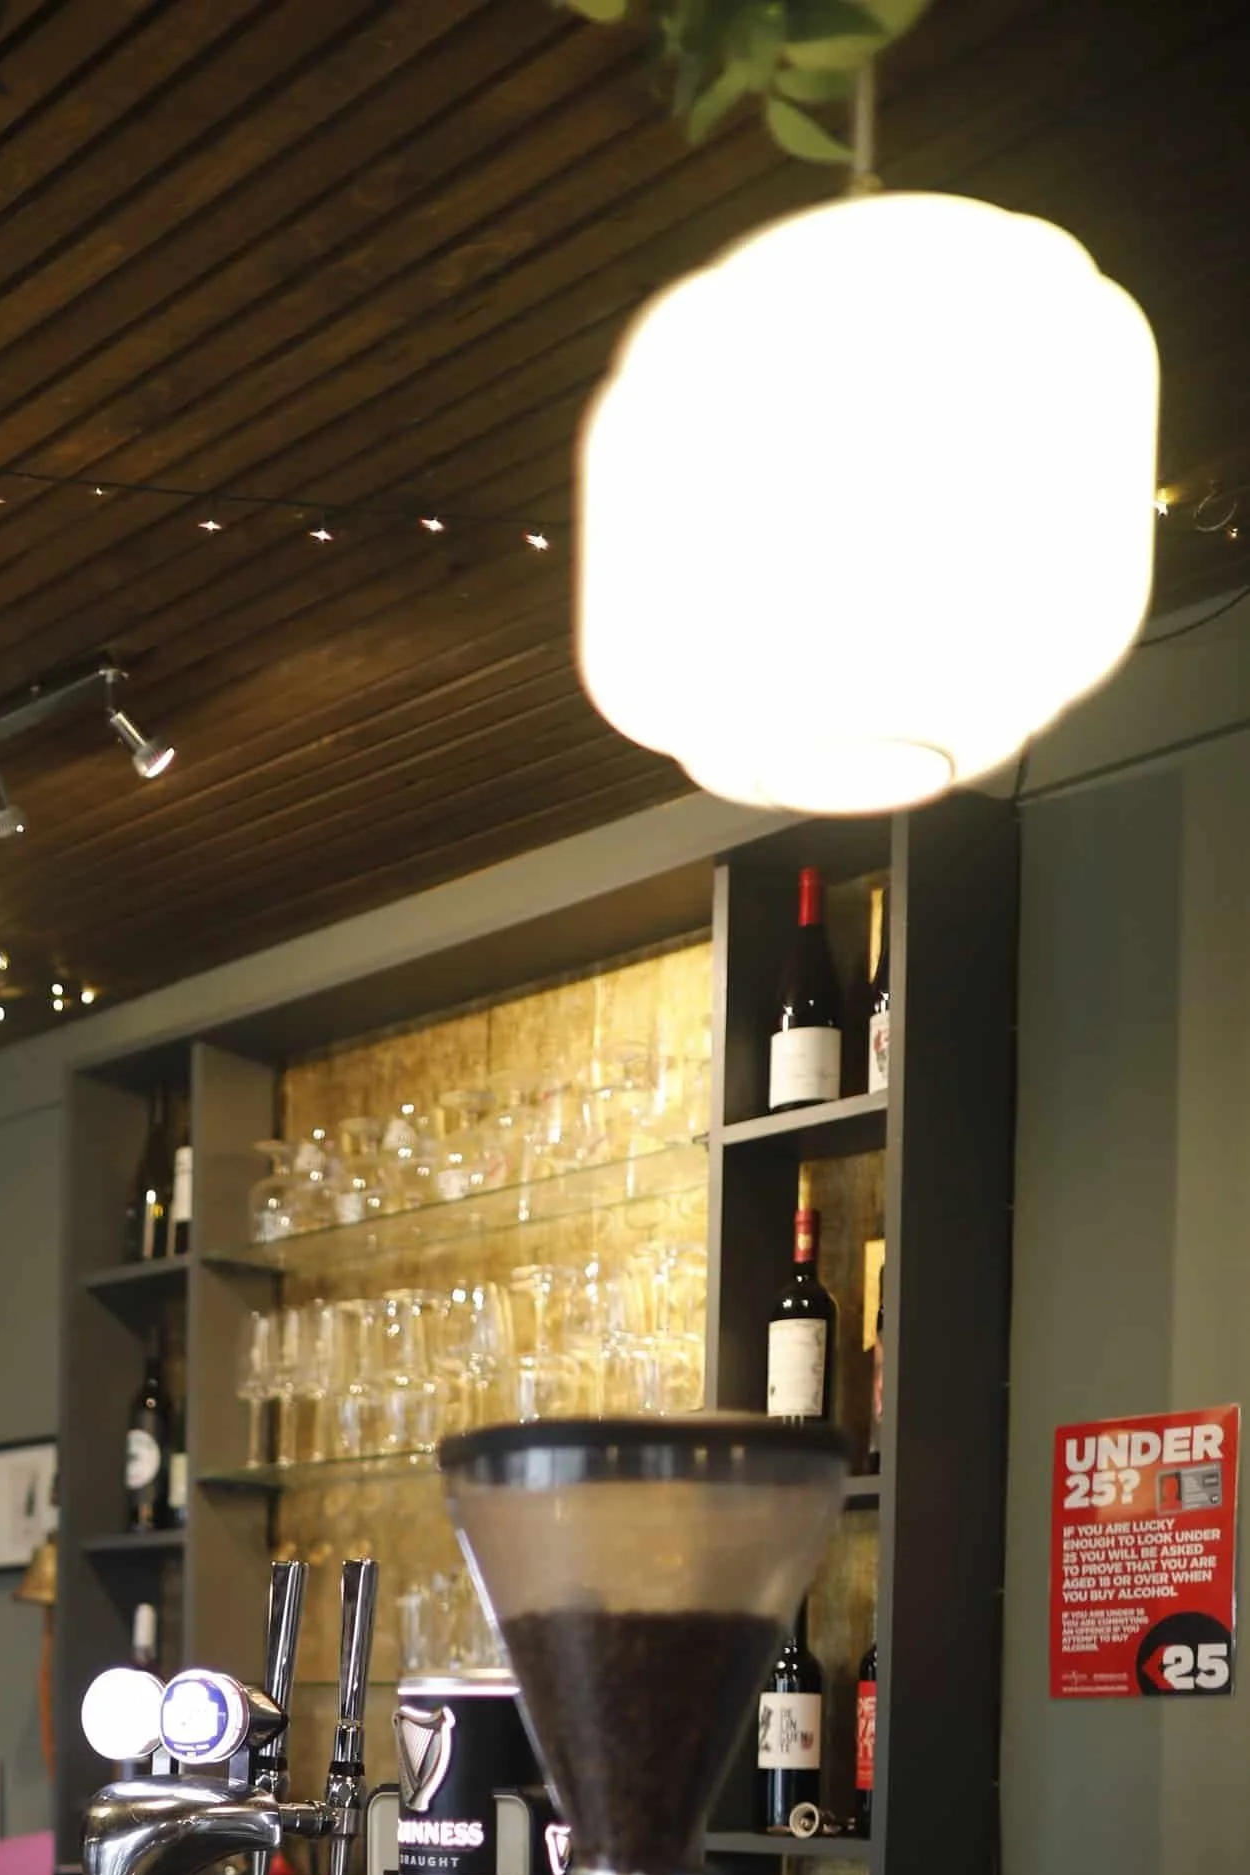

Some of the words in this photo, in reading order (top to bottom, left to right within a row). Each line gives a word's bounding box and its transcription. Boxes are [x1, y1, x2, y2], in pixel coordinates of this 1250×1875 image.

[1065, 1424, 1224, 1473] UNDER
[1064, 1468, 1141, 1509] 25?
[1063, 1526, 1075, 1538] IF
[1077, 1524, 1103, 1537] YOU
[1105, 1521, 1130, 1536] ARE
[1132, 1518, 1175, 1534] LUCKY
[1063, 1536, 1116, 1550] ENOUGH
[1117, 1534, 1135, 1548] TO
[1137, 1531, 1173, 1546] LOOK
[1175, 1527, 1221, 1543] UNDER
[1063, 1551, 1078, 1563] 25
[1079, 1549, 1105, 1563] YOU
[1108, 1547, 1139, 1562] WILL
[1141, 1546, 1158, 1559] BE
[1160, 1543, 1204, 1558] ASKED
[1062, 1564, 1080, 1577] TO
[1081, 1561, 1123, 1577] PROVE
[1125, 1560, 1158, 1574] THAT
[1160, 1557, 1188, 1571] YOU
[1190, 1554, 1217, 1569] ARE
[1062, 1576, 1096, 1590] AGED
[1113, 1573, 1131, 1587] OR
[1133, 1571, 1168, 1586] OVER
[1171, 1569, 1213, 1584] WHEN
[1062, 1589, 1088, 1604] YOU
[1090, 1588, 1115, 1601] BUY
[1163, 1643, 1229, 1690] 25
